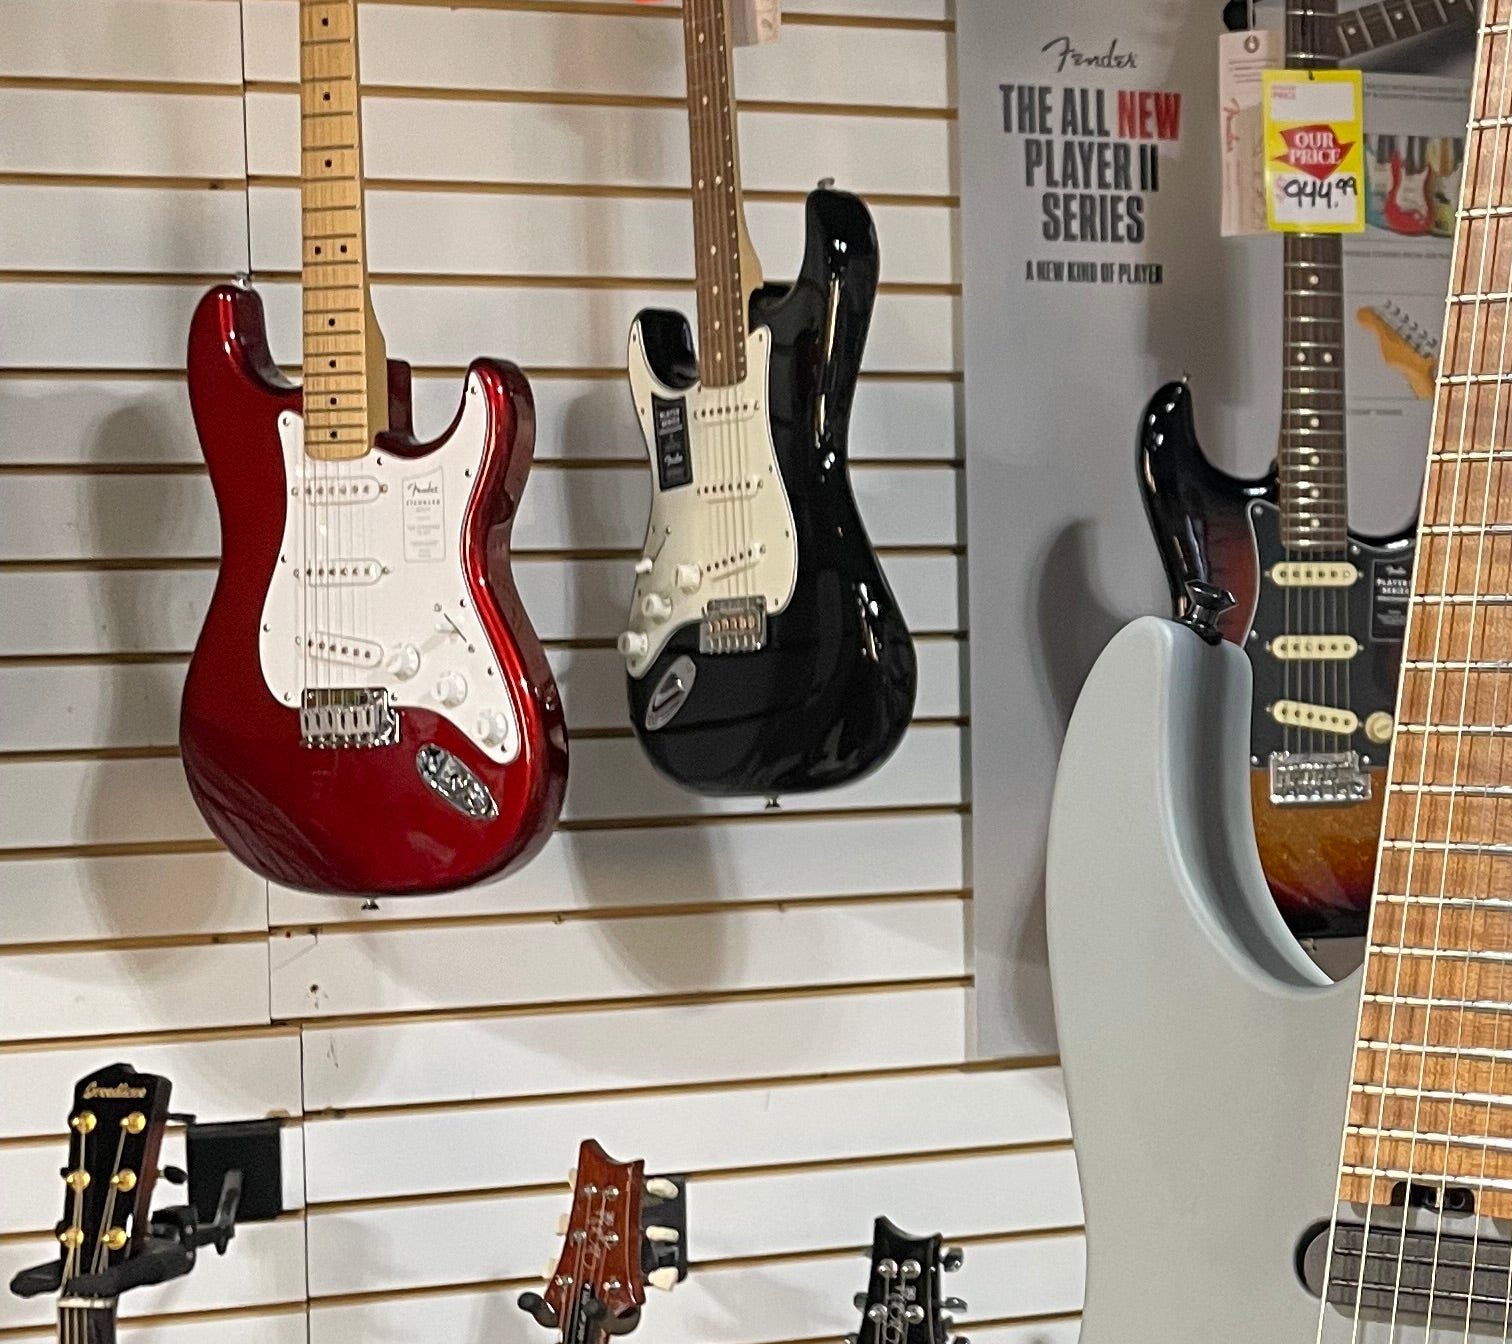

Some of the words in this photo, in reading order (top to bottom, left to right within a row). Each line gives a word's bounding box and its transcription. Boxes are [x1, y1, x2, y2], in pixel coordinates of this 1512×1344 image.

[1041, 36, 1137, 73] Fender
[999, 84, 1053, 135] THE
[1061, 87, 1111, 138] ALL
[1117, 90, 1182, 141] NEW
[1289, 148, 1341, 165] PRICE
[1295, 131, 1334, 148] OUR
[1025, 138, 1132, 191] PLAYER
[1139, 144, 1160, 193] II
[1042, 192, 1145, 244] SERIES
[1026, 260, 1035, 281] A
[1036, 261, 1065, 282] NEW
[1067, 262, 1098, 283] KIND
[1100, 263, 1115, 283] OF
[1118, 264, 1163, 284] PLAYER
